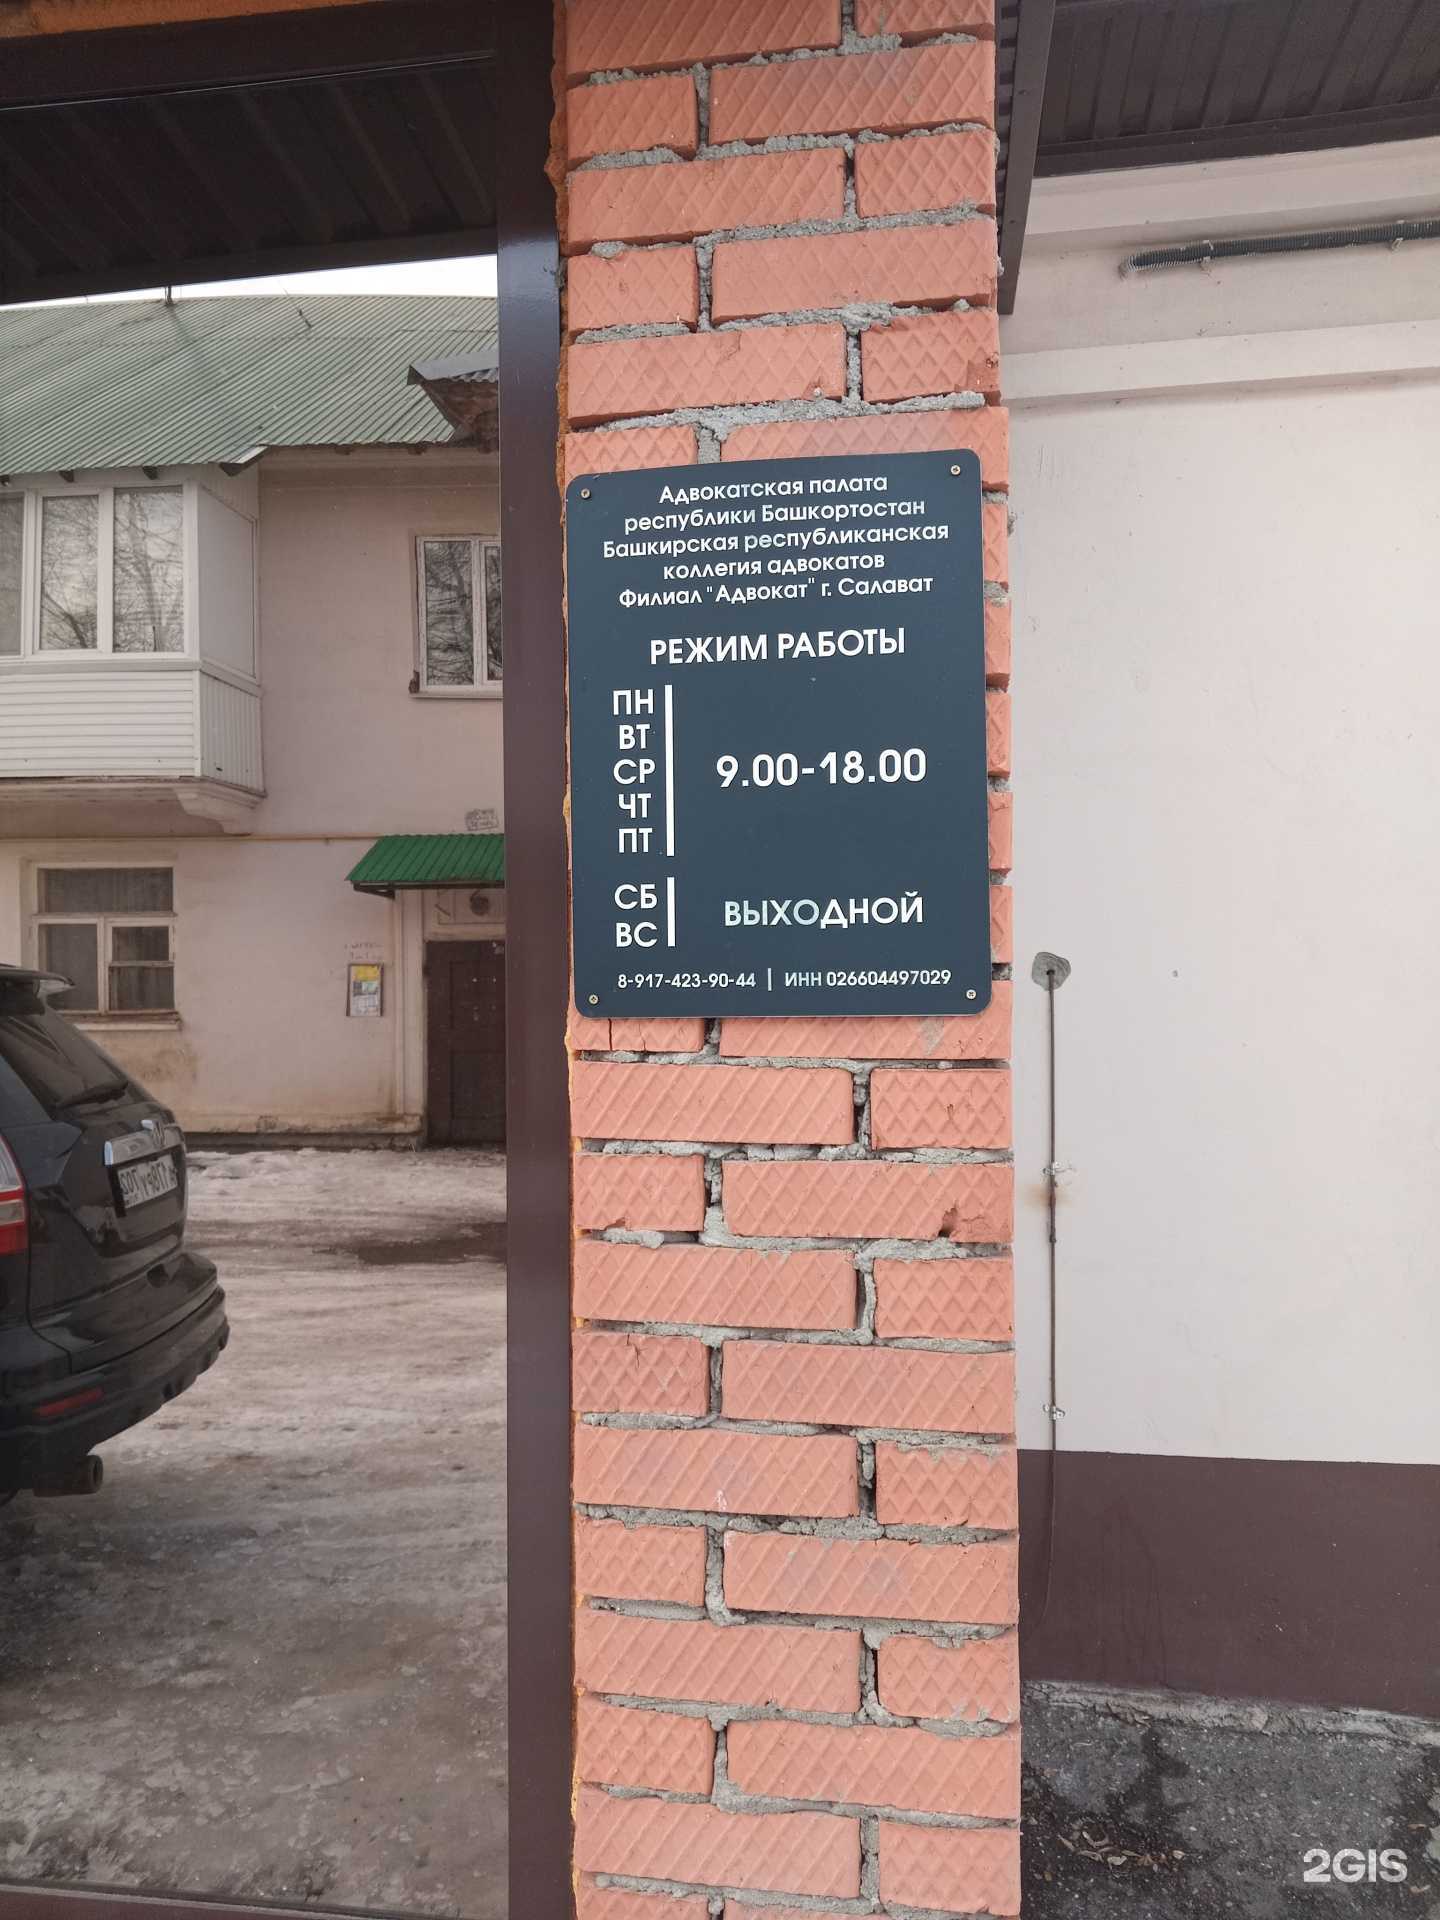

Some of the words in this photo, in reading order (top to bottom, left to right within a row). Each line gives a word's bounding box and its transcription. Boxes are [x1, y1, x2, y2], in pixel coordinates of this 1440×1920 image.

[659, 481, 803, 505] Адвокатская
[810, 477, 887, 493] палата
[625, 509, 755, 535] республики
[762, 501, 925, 522] Башкортостан
[604, 536, 738, 558] Башкирская
[745, 525, 948, 552] республиканская
[664, 561, 761, 579] коллегия
[767, 555, 884, 575] адвокатов
[619, 589, 702, 608] Филиал
[707, 577, 814, 604] "Адвокат"
[822, 583, 831, 596] г.
[838, 578, 933, 595] Салават
[651, 634, 767, 664] РЕЖИМ
[778, 628, 904, 659] РАБОТЫ
[613, 689, 653, 715] ПН
[619, 724, 650, 749] ВТ
[614, 759, 655, 784] СР
[717, 748, 926, 787] 9.00-18.00
[619, 793, 651, 818] ЧТ
[619, 828, 652, 853] ПТ
[615, 884, 657, 909] СБ
[725, 891, 922, 929] ВЫХОДНОЙ
[616, 922, 657, 947] ВС
[618, 973, 756, 988] 8-917-423-90-44
[785, 972, 821, 986] ИНН
[827, 970, 951, 986] 026604497029
